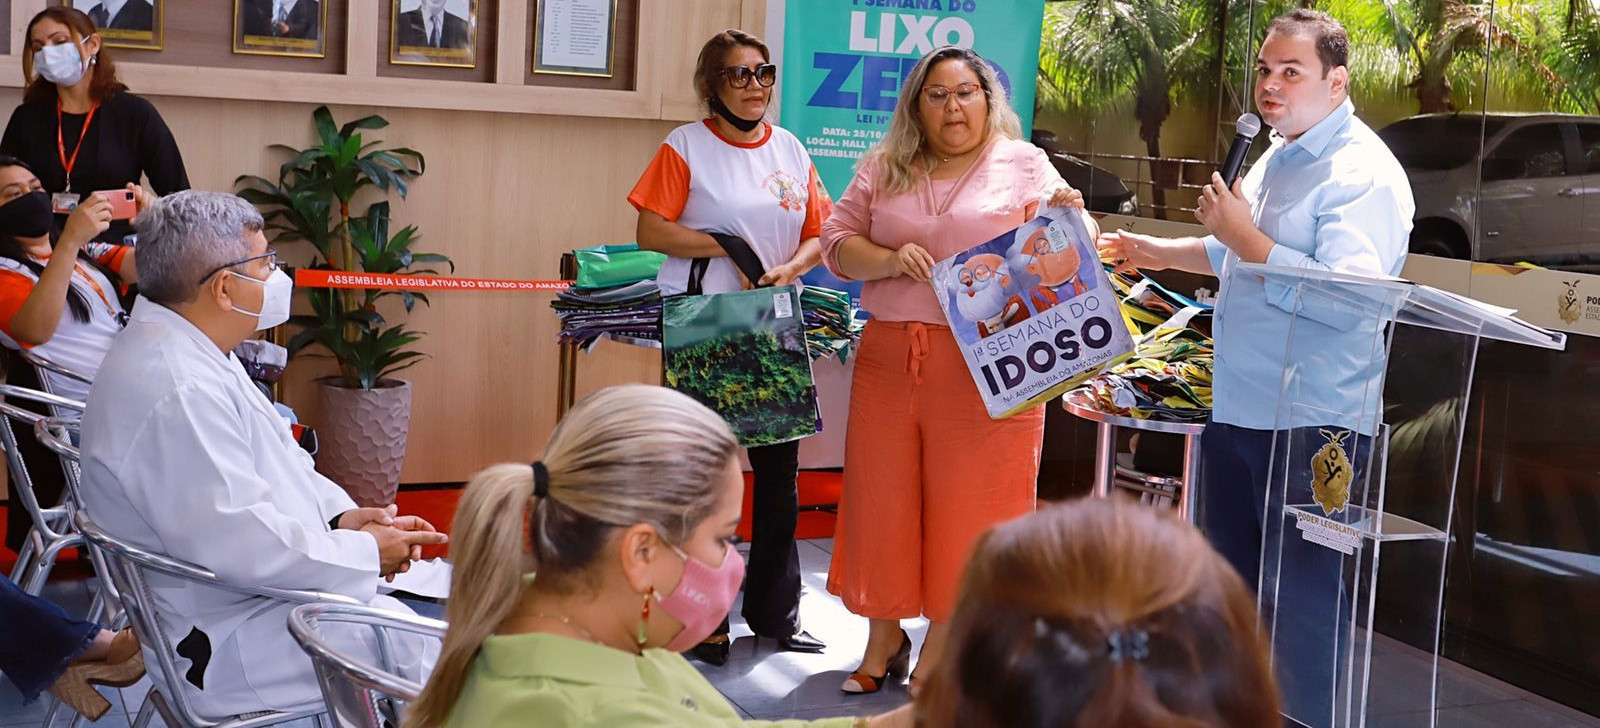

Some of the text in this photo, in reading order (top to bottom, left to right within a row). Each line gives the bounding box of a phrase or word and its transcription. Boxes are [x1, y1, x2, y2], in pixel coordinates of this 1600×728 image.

[949, 0, 976, 13] DO
[849, 10, 975, 56] LIXO
[856, 113, 873, 124] LEI
[822, 127, 851, 137] DATA:
[806, 136, 840, 147] LOCAL:
[842, 139, 867, 149] HALL
[327, 274, 394, 286] ASSEMBLEIA
[395, 278, 460, 288] LEGISLATIVA
[461, 280, 476, 288] DO
[477, 281, 517, 289] ESTADO
[986, 312, 1067, 357] SEMANA
[1069, 295, 1100, 318] DO
[980, 316, 1113, 397] IDOSO
[1002, 394, 1014, 403] NA
[1015, 375, 1058, 398] ASSEMBLEIA
[1072, 350, 1113, 371] AMAZONAS
[1297, 511, 1320, 525] PODER
